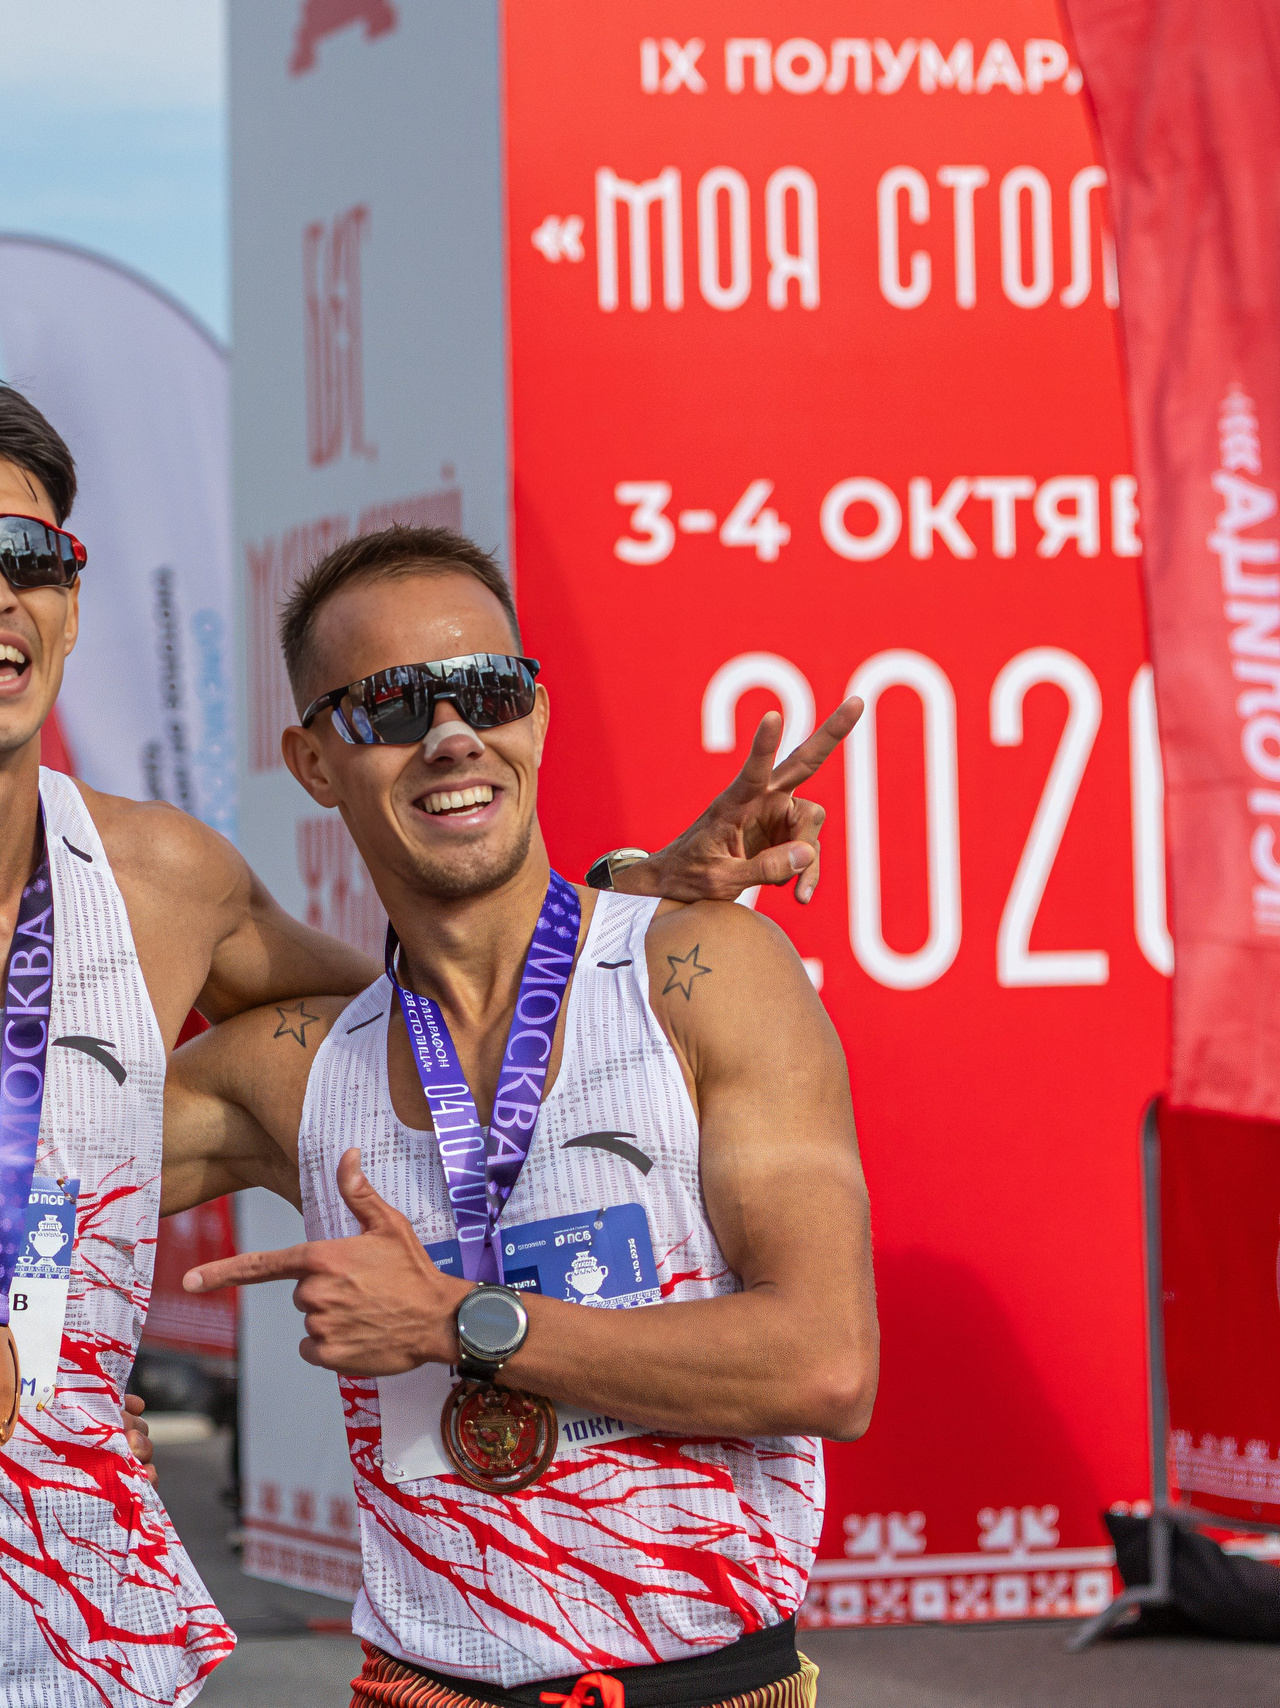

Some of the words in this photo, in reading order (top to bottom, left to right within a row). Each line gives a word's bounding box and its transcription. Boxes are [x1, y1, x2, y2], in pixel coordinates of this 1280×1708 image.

[639, 37, 707, 94] IX
[531, 164, 820, 313] «МОЯ
[876, 164, 1120, 310] СТОЛ
[613, 477, 791, 566] 3-4
[701, 645, 1176, 991] 202
[487, 941, 574, 1166] МОСКВА
